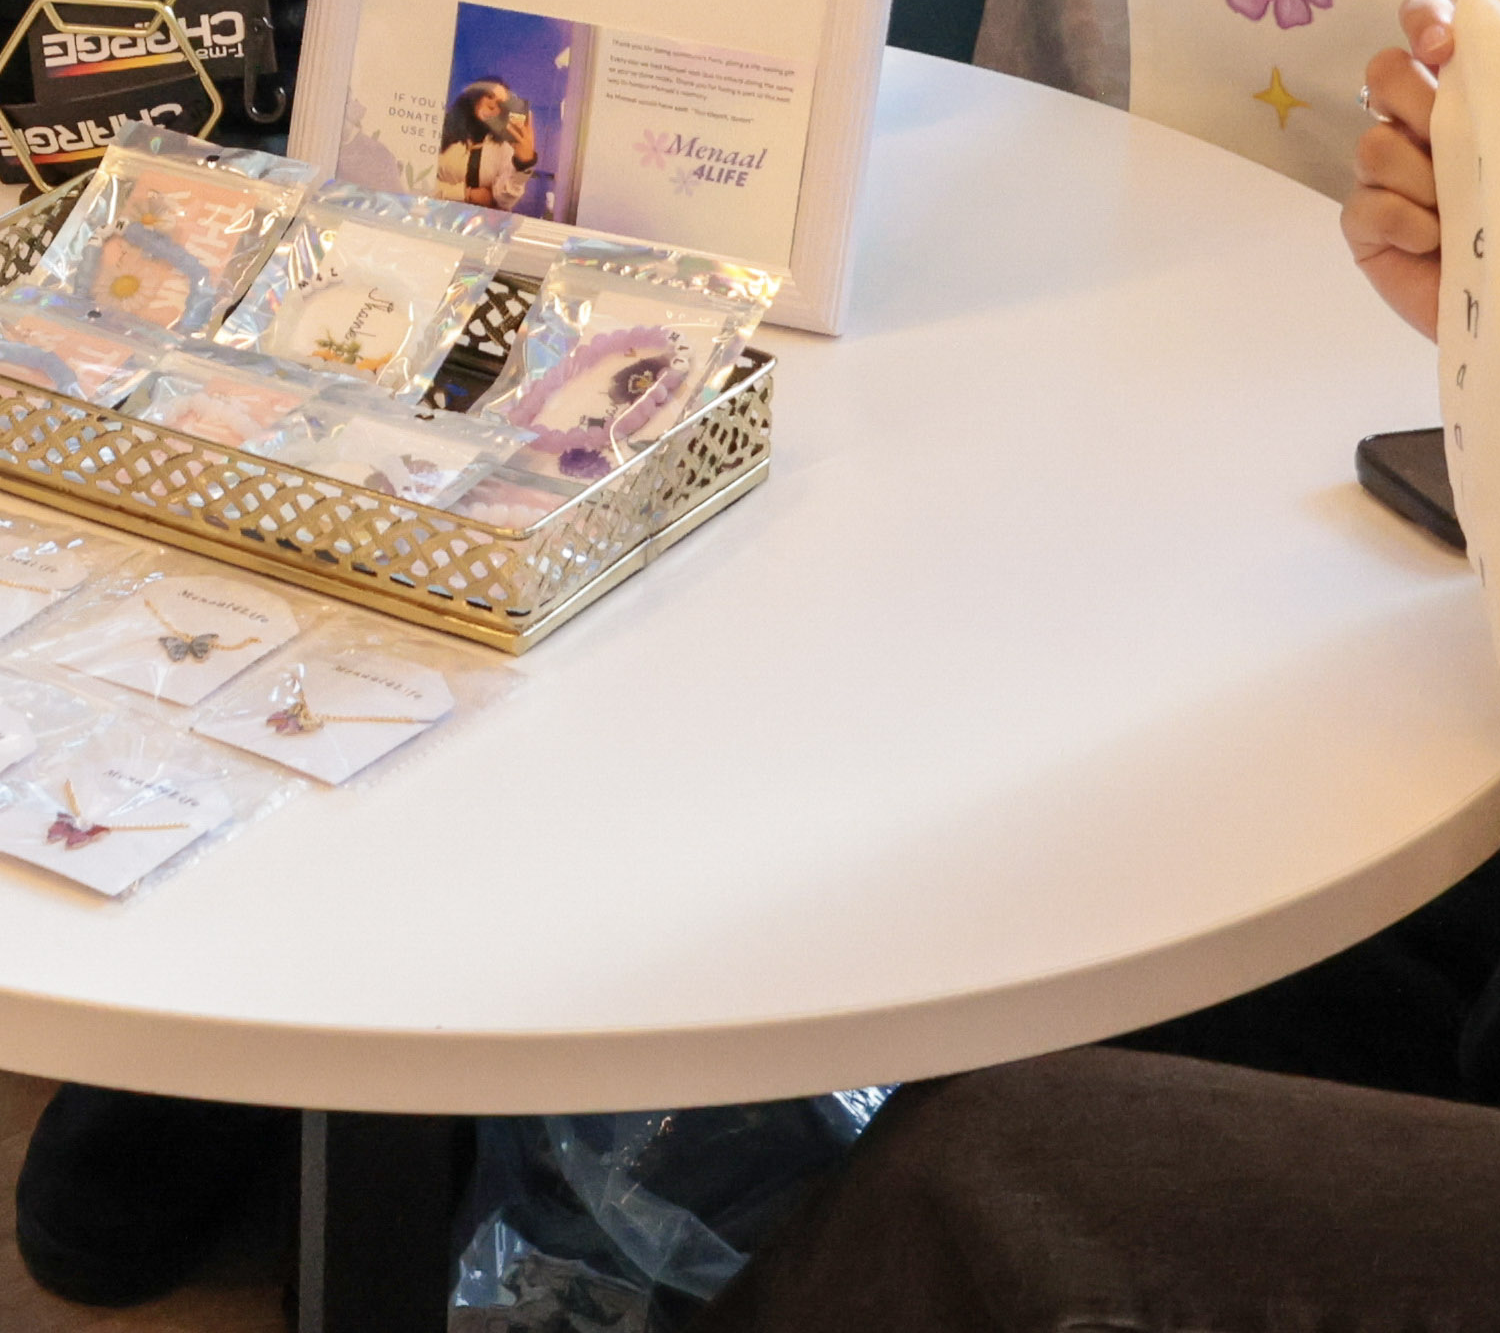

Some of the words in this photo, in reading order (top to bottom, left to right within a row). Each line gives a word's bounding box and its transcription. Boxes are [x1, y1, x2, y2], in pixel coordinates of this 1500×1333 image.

[393, 92, 406, 102] IF
[411, 95, 436, 108] YOU
[388, 107, 439, 125] DONATE
[401, 125, 425, 137] USE
[664, 133, 768, 170] Menaal
[692, 164, 749, 187] 4LIFE
